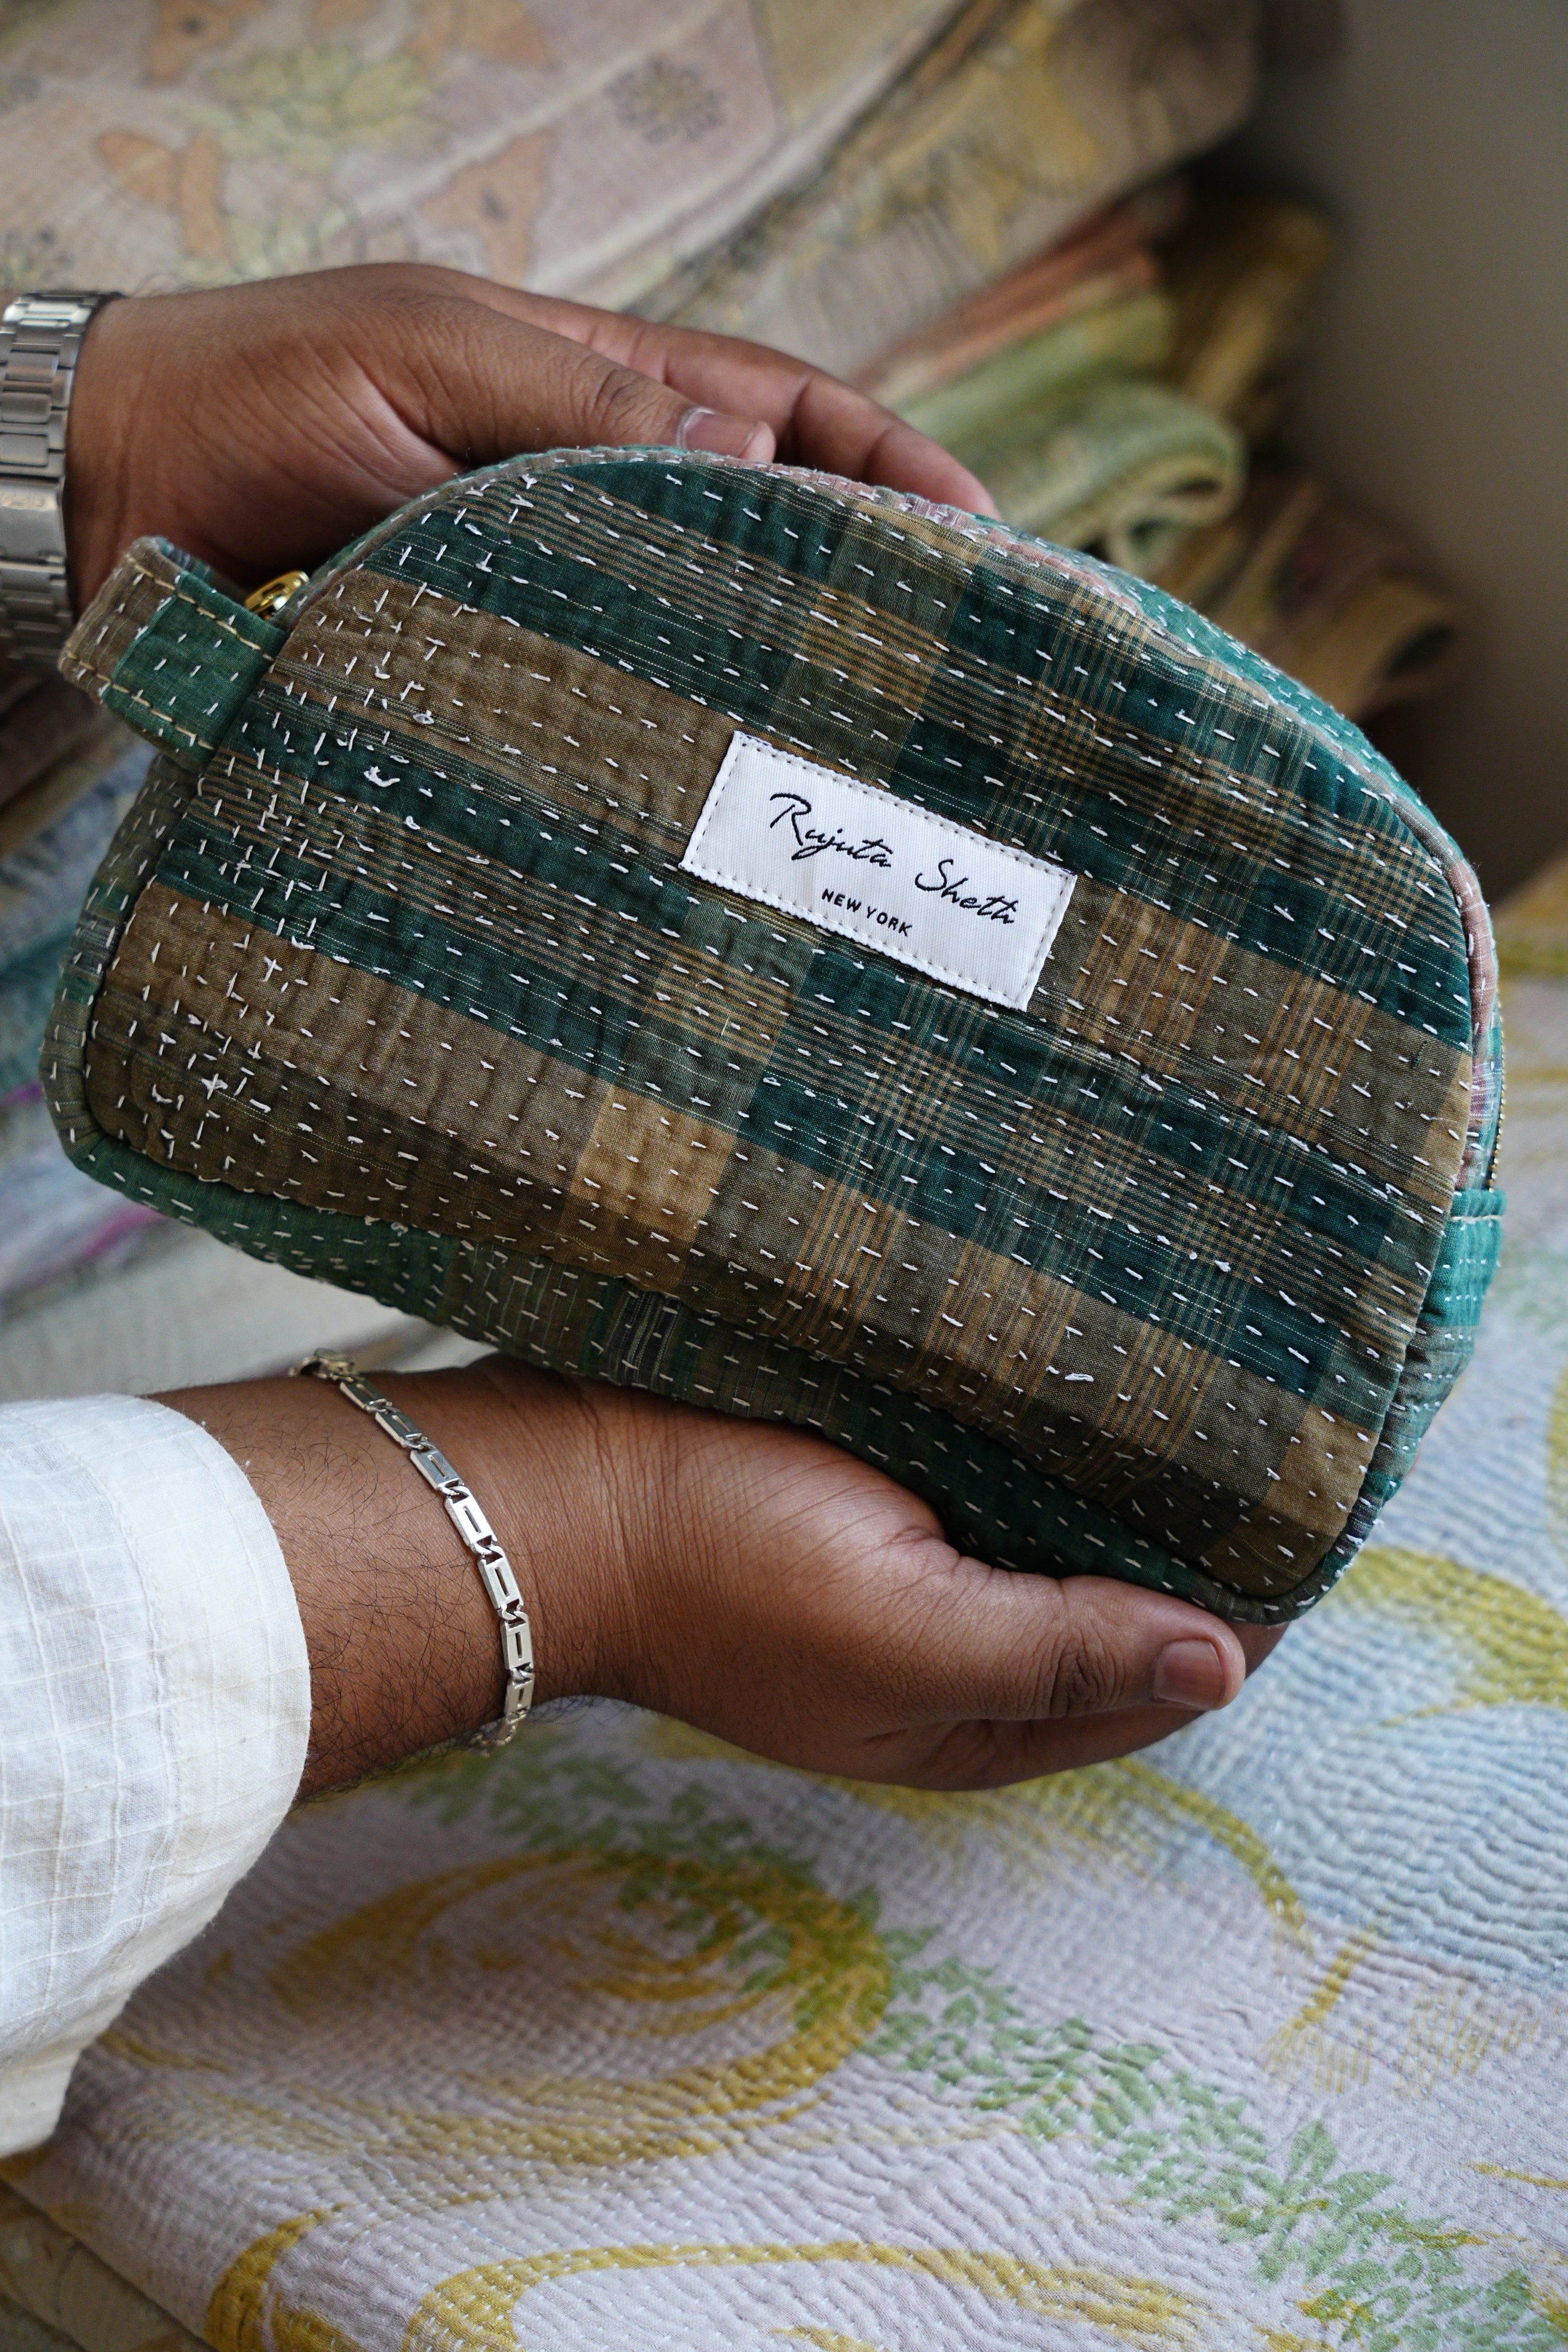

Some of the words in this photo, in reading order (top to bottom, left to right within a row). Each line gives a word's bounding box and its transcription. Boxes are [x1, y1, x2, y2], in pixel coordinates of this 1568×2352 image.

[769, 793, 893, 868] Rujuta
[915, 859, 1019, 924] Sheth
[821, 888, 862, 913] NEW
[867, 905, 913, 937] YORK
